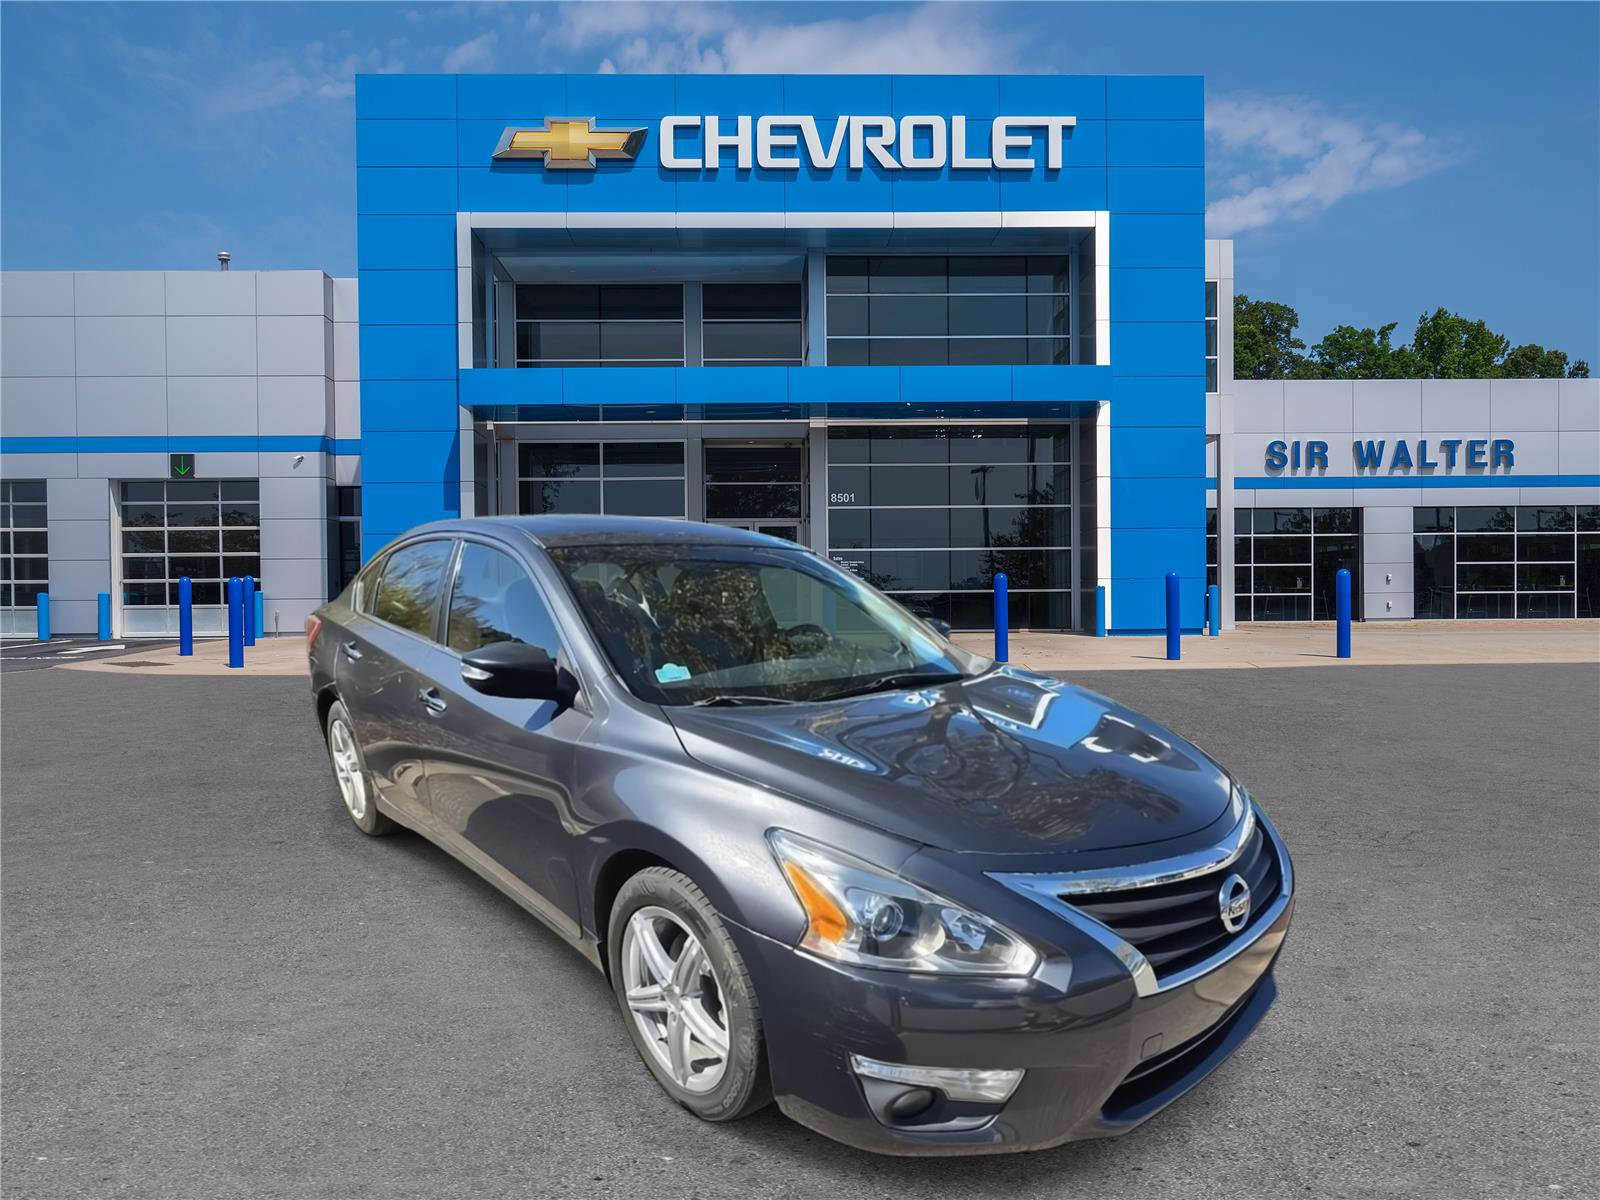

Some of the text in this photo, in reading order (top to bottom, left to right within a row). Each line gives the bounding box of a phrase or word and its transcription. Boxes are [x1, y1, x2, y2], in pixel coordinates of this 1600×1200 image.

[659, 115, 1077, 170] CHEVROLET
[1265, 439, 1515, 470] SIR WALTER
[830, 493, 855, 503] 8501
